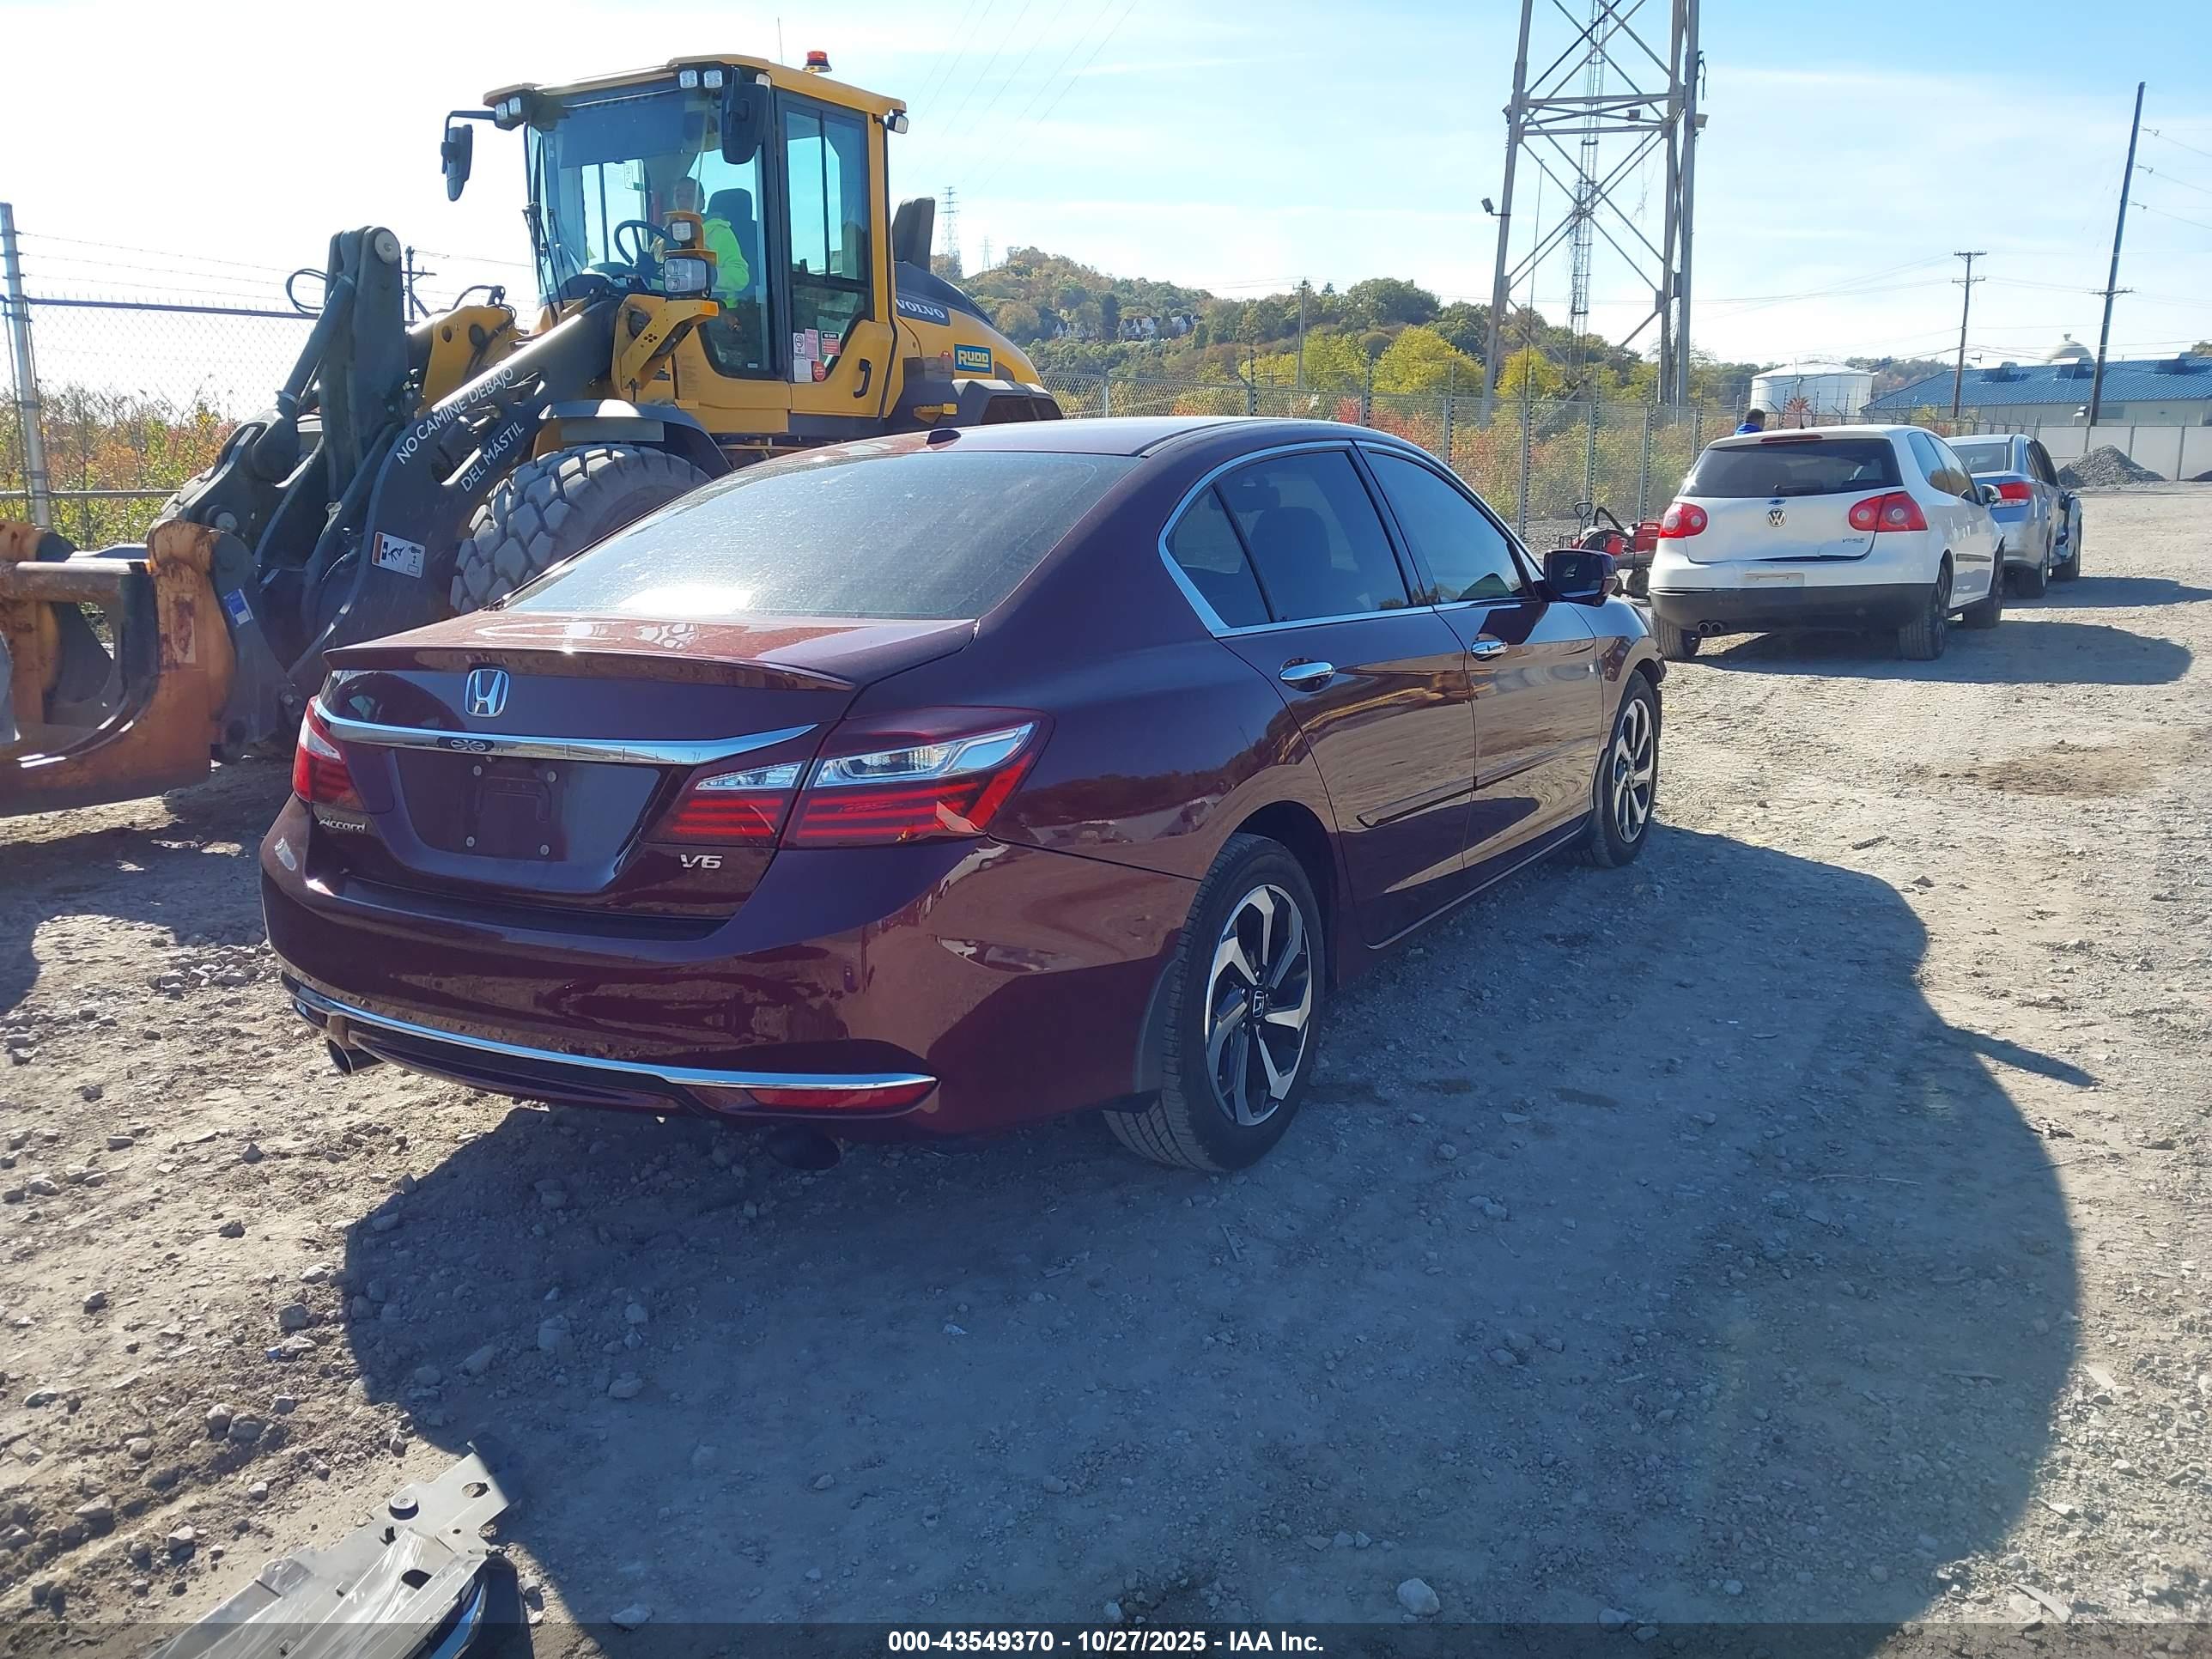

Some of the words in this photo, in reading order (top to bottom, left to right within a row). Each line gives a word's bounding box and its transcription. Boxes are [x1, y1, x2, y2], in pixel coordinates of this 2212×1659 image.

[896, 299, 945, 319] VOLVO
[957, 349, 989, 366] RUDD
[396, 437, 418, 465] NO
[416, 398, 468, 440] CAMINE
[468, 367, 514, 404] DEBAJO
[460, 465, 486, 492] DEL
[483, 422, 525, 465] MÁSTIL
[319, 817, 366, 831] Accord
[680, 854, 722, 868] V6
